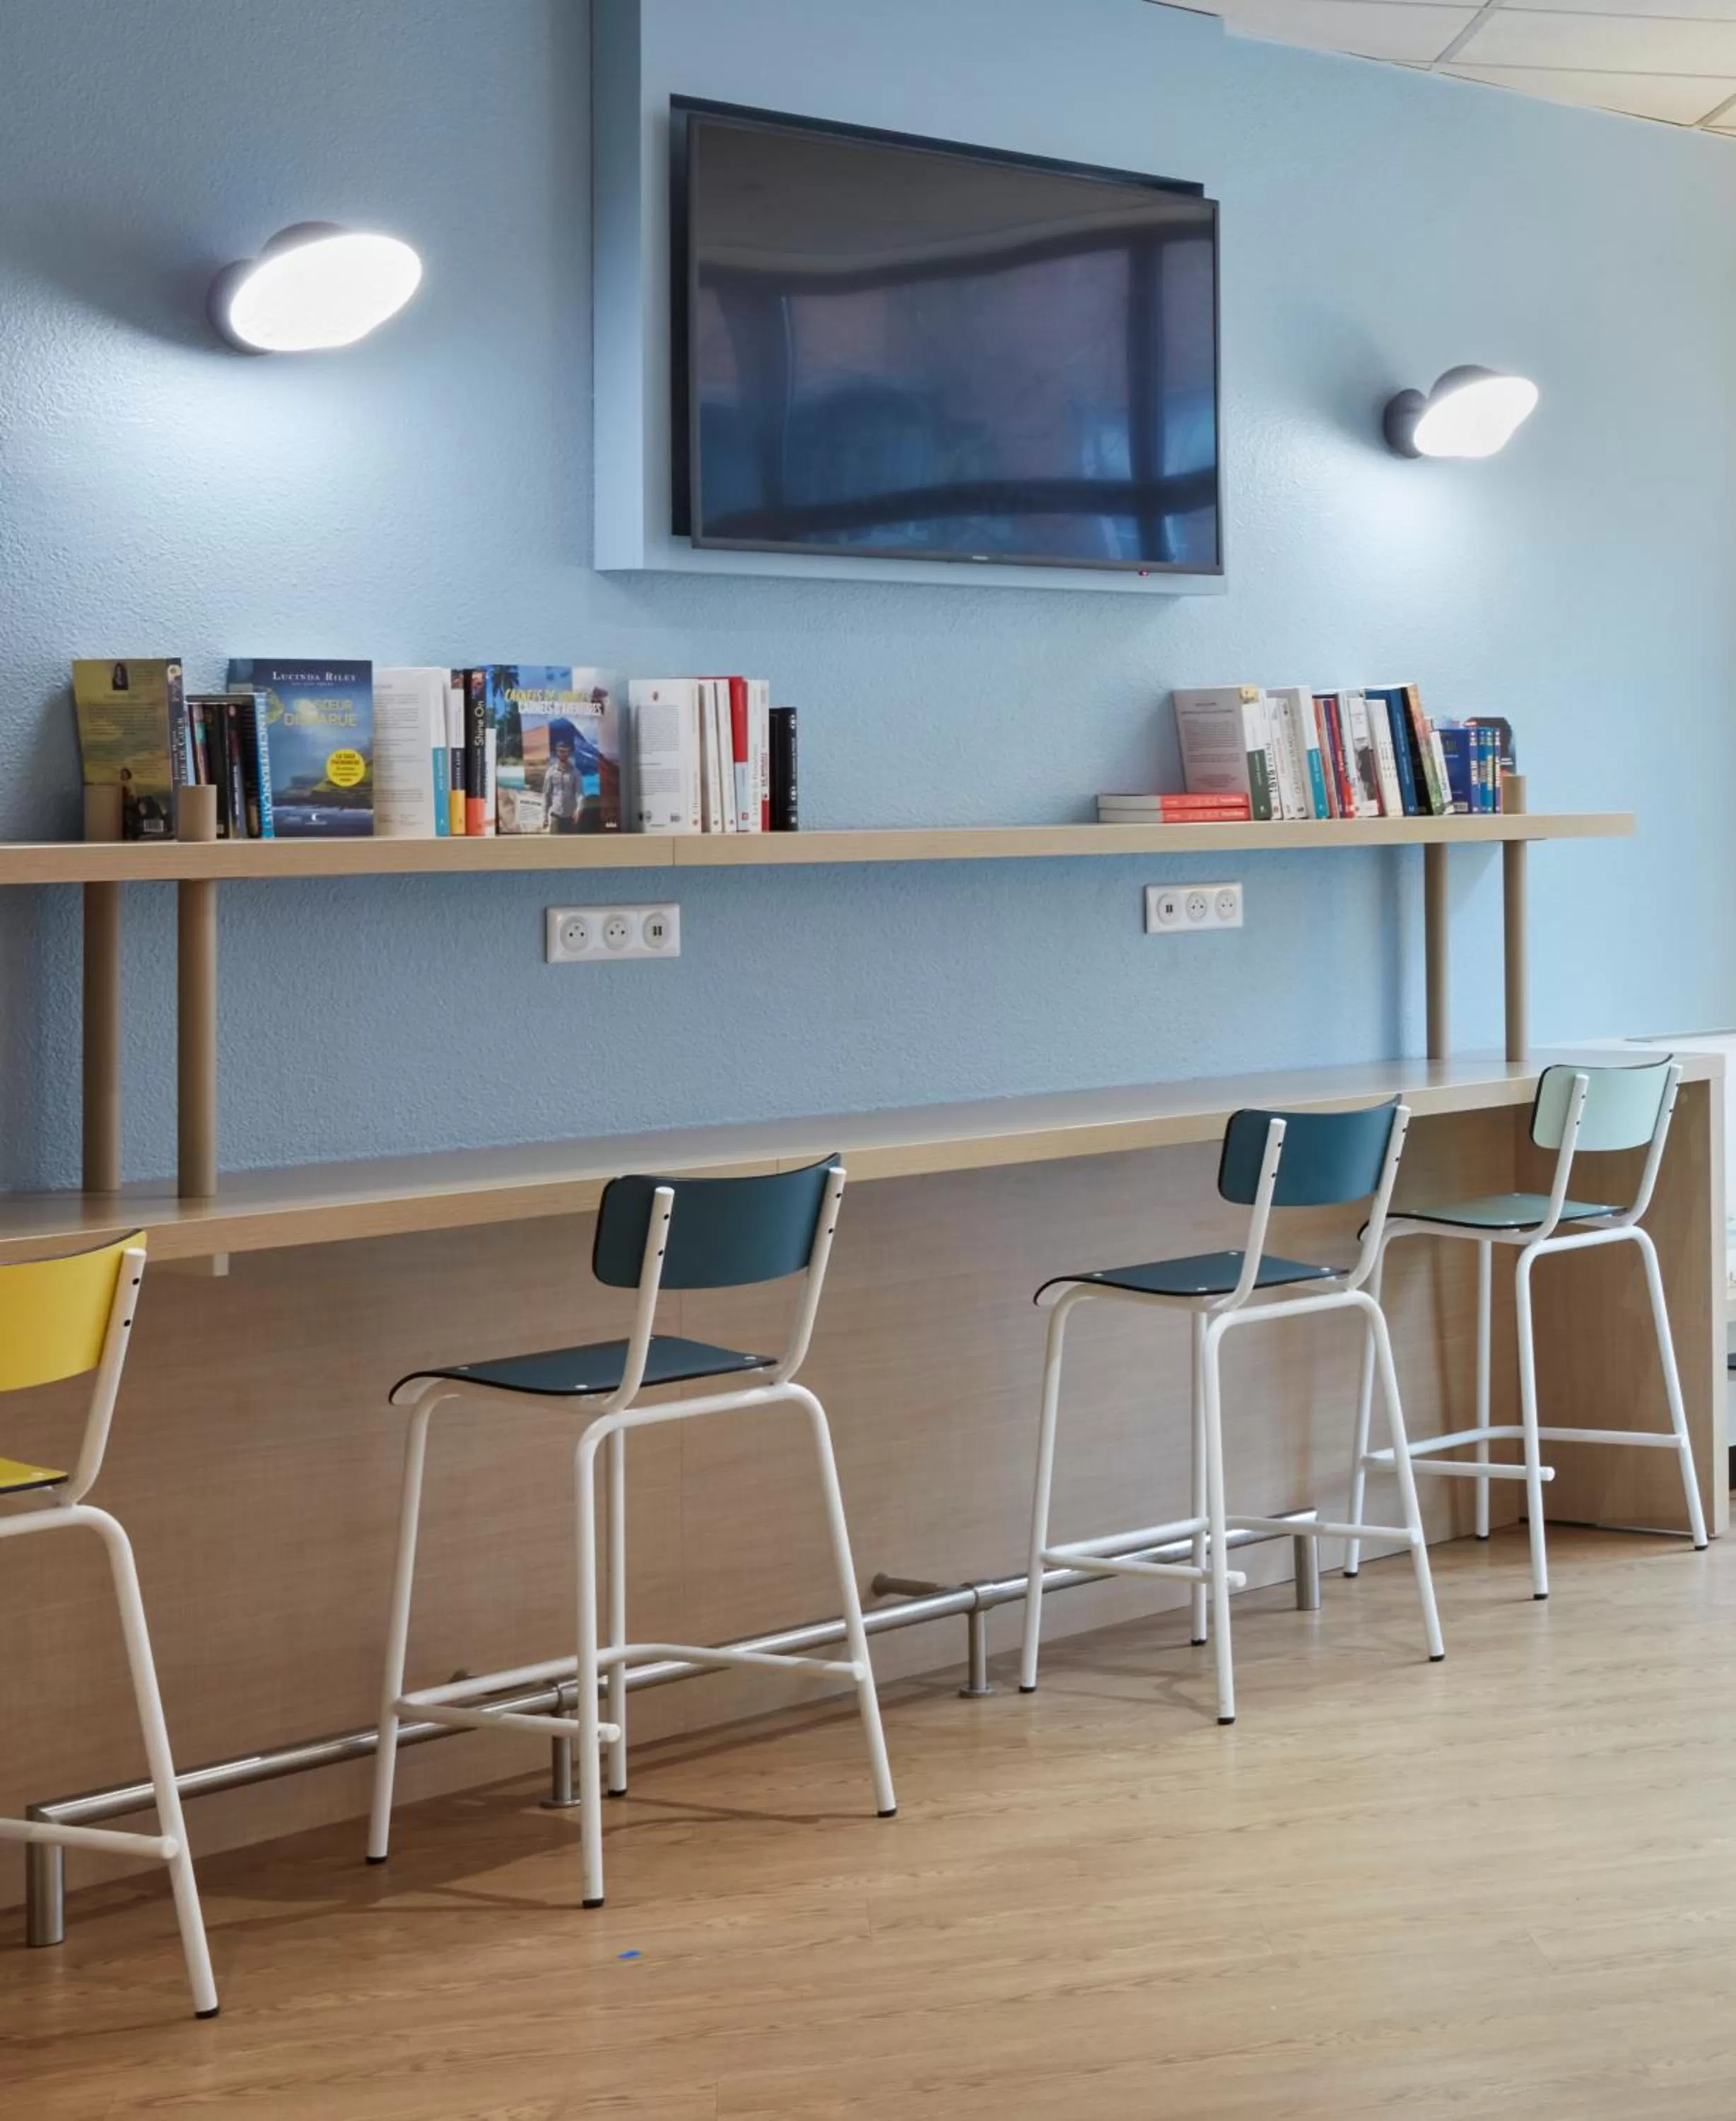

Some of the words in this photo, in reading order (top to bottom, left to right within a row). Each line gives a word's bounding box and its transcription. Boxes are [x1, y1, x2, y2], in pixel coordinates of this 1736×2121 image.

[272, 671, 320, 682] LUCINDA
[325, 671, 357, 682] RILEY
[474, 701, 485, 718] On
[475, 719, 484, 746] Shine
